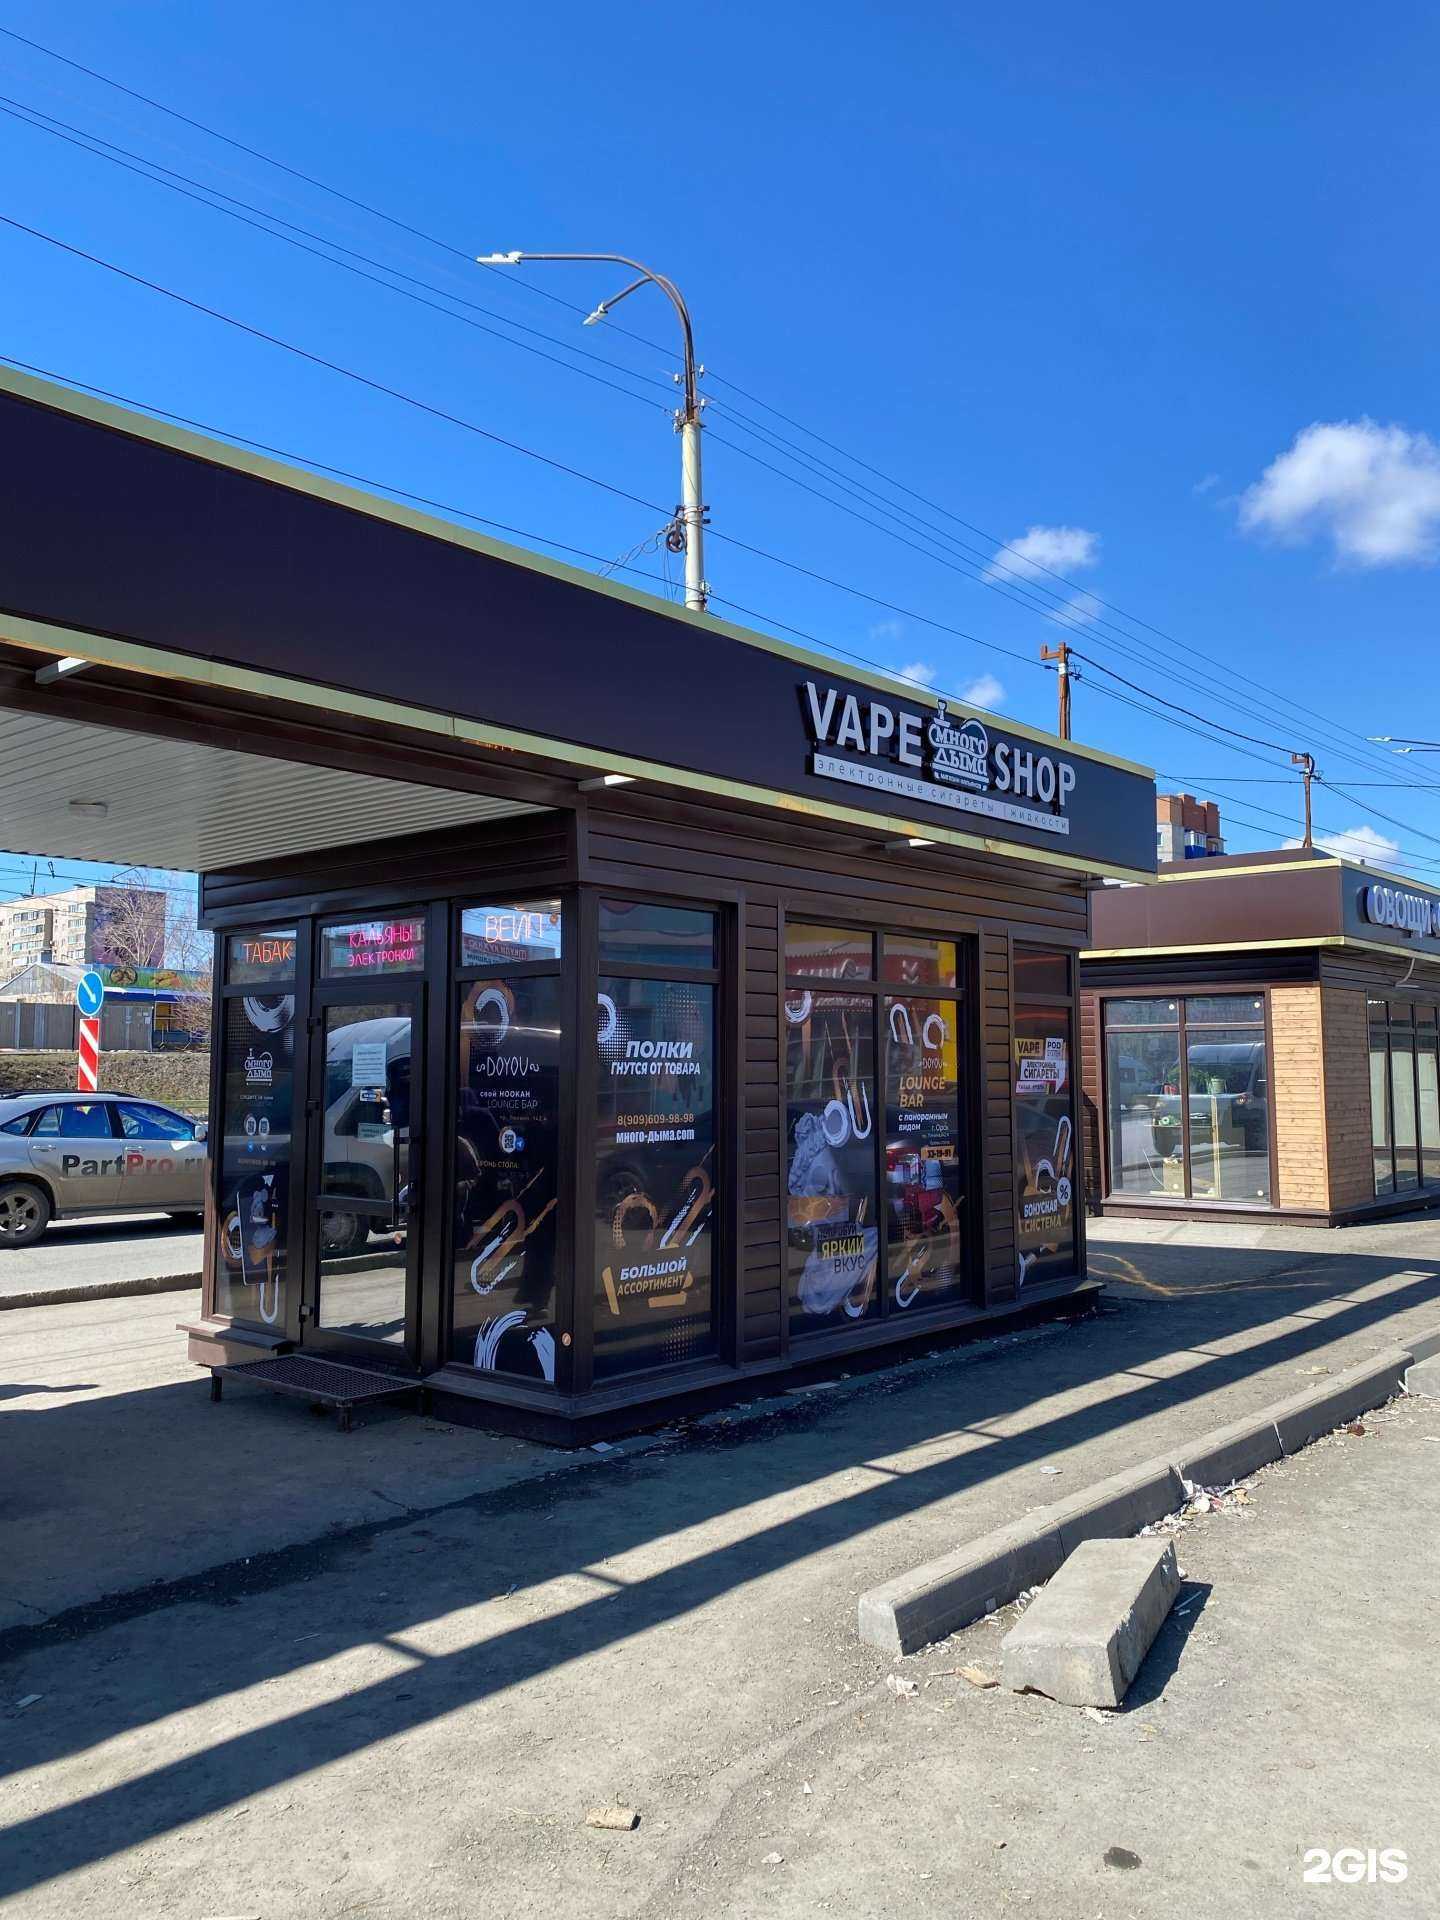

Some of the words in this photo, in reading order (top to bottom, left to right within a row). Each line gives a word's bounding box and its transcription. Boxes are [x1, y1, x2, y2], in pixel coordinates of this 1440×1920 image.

[806, 680, 922, 767] VAPE
[935, 725, 987, 756] МНОГО
[933, 747, 987, 777] ДЫМА
[995, 742, 1076, 806] SHOP
[818, 759, 924, 794] электронные
[931, 788, 994, 813] сигареты
[1010, 808, 1067, 831] жидкости
[1373, 886, 1432, 938] ОВОЩИ
[348, 923, 413, 948] КАЛЬЯНЫ
[242, 941, 292, 964] ТАБАК
[348, 947, 415, 968] ЭЛЕКТРОНКИ
[625, 1040, 693, 1060] ПОЛКИ
[1017, 1040, 1041, 1054] VAPE
[1047, 1041, 1062, 1049] POD
[246, 1060, 272, 1070] МНОГО
[486, 1056, 529, 1076] DOYOU
[611, 1061, 648, 1076] ГНУТСЯ
[649, 1062, 662, 1076] ОТ
[664, 1062, 701, 1076] ТОВАРА
[1023, 1068, 1060, 1080] СИГАРЕТЫ
[899, 1076, 947, 1091] LOUNGE
[480, 1090, 498, 1099] свой
[899, 1093, 925, 1108] BAR
[487, 1099, 520, 1110] LOUNGE
[521, 1099, 539, 1110] БАР
[617, 1113, 695, 1128] 8(909)609-98-98
[904, 1112, 948, 1123] панорамным
[616, 1129, 695, 1145] много-дыма.com
[898, 1124, 921, 1132] видом
[1024, 1199, 1058, 1218] БОНУСНАЯ
[1024, 1214, 1063, 1232] СИСТЕМА
[822, 1231, 864, 1260] ЯРКИЙ
[620, 1256, 688, 1281] БОЛЬШОЙ
[834, 1254, 865, 1273] ВКУС
[617, 1274, 685, 1297] АССОРТИМЕНТ
